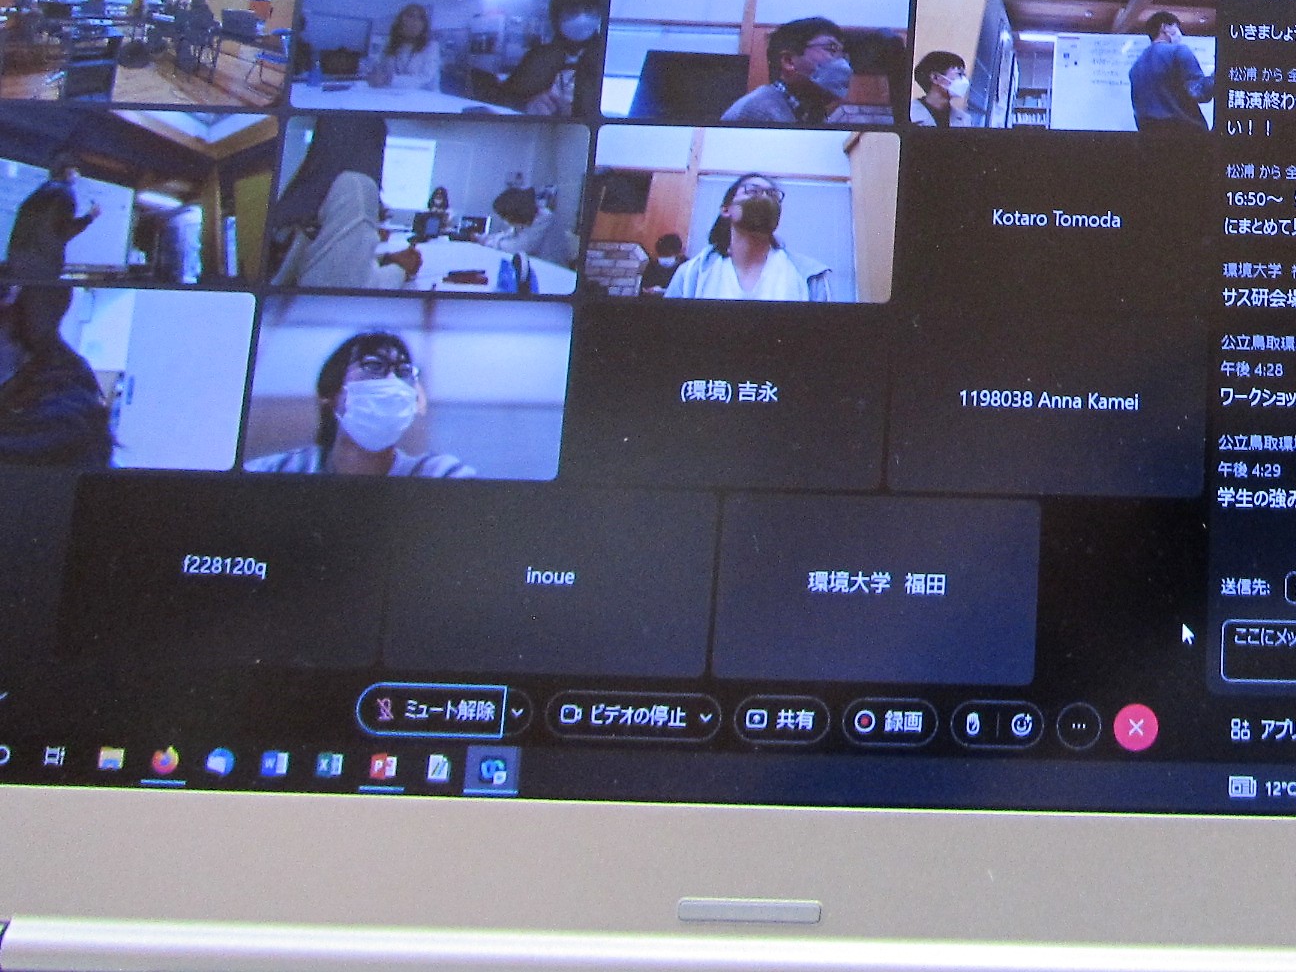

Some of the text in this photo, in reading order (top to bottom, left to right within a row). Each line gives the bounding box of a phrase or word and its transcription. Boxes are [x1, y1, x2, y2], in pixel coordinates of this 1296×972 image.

[1228, 66, 1258, 82] 松浦
[1261, 67, 1284, 83] から
[1226, 163, 1255, 179] 松浦
[1258, 164, 1282, 180] から
[992, 208, 1122, 229] Kotaro Tomoda
[1223, 262, 1282, 279] 環境大学
[1220, 360, 1284, 378] 午後 4:28
[680, 379, 778, 404] (環境) 吉永
[959, 389, 1139, 411] 1198038 Anna Kamei
[1217, 460, 1282, 479] 午後 4:29
[182, 554, 267, 581] f228120q
[525, 566, 576, 586] inoue
[807, 570, 946, 596] 環境大学 福田
[1220, 577, 1271, 597] 送信先:
[404, 699, 496, 722] ミュート解除
[590, 703, 687, 729] ビデオの停止
[775, 708, 815, 731] 共有
[883, 709, 923, 733] 録画
